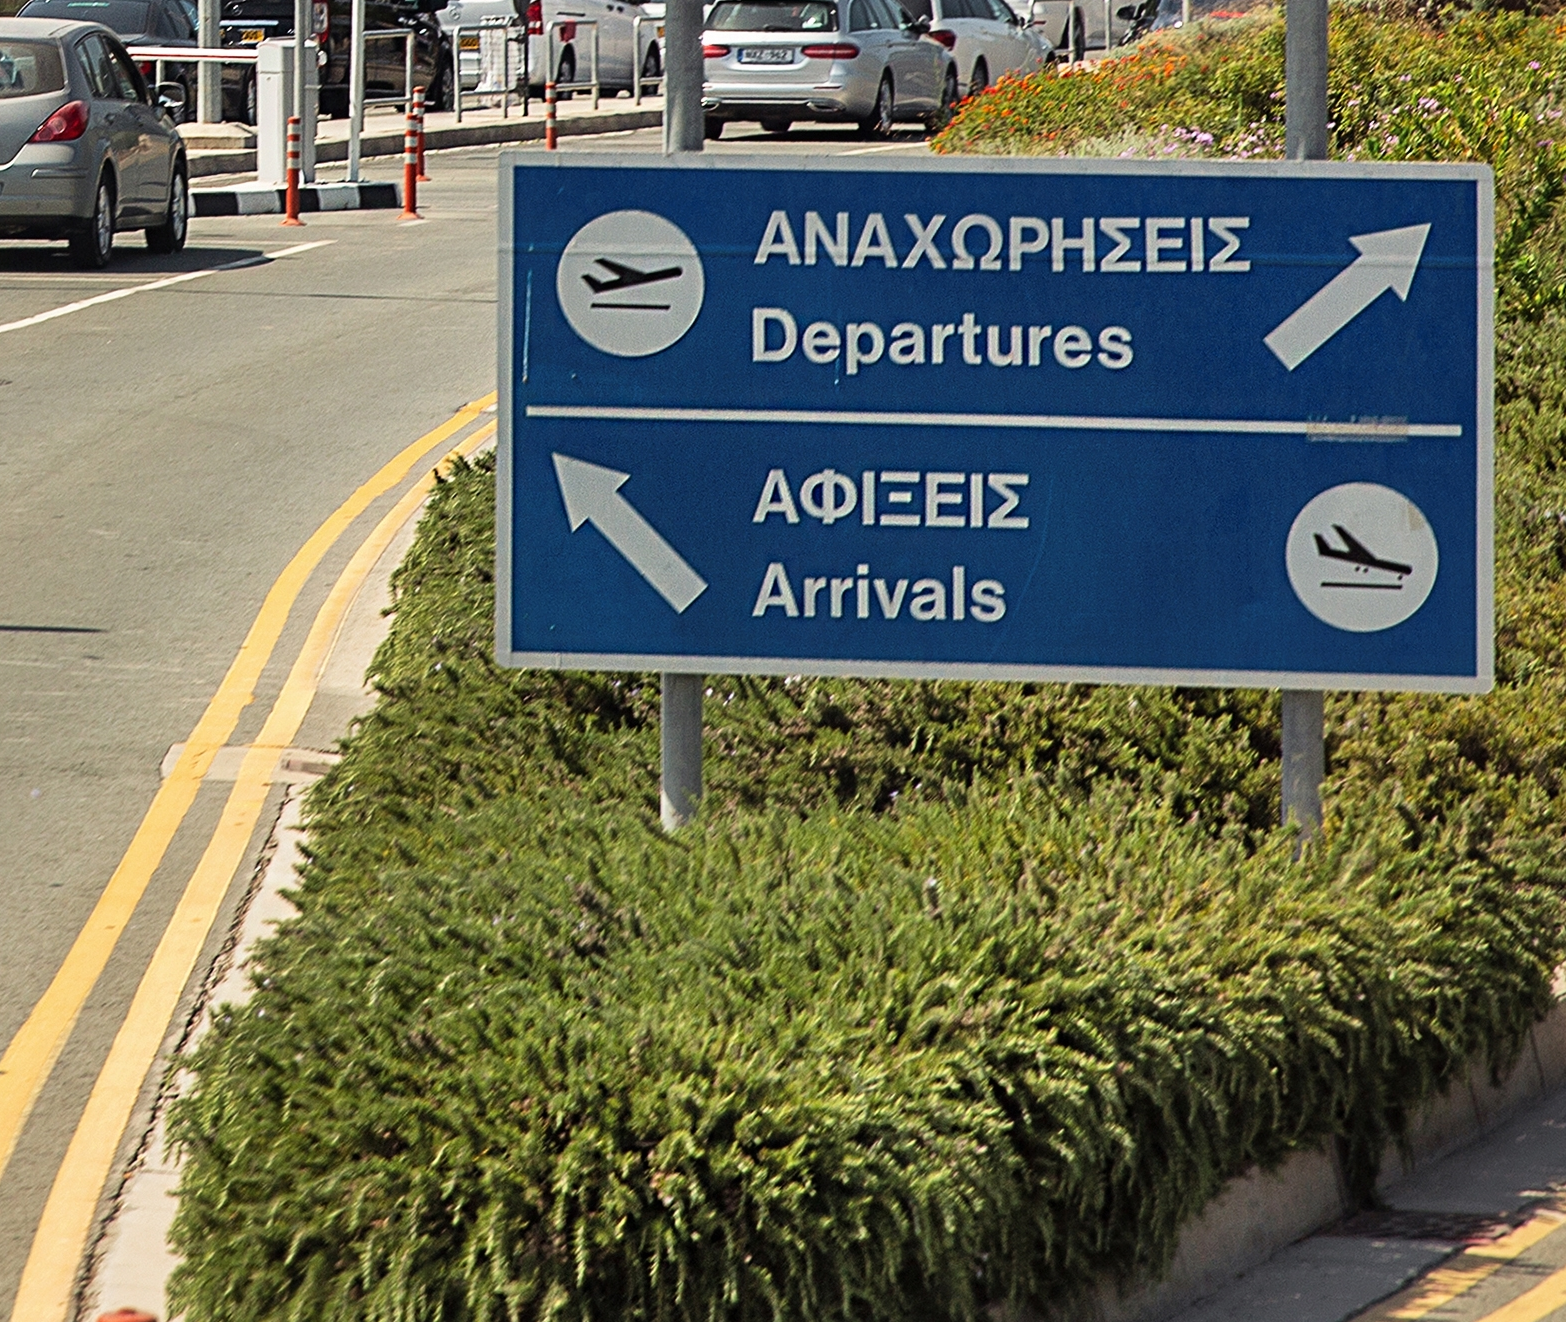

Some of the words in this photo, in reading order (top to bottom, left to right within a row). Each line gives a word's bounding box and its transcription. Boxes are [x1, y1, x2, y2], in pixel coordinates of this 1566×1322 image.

[753, 211, 1251, 274] ΑΝΑΧΩΡΗΣΕΙΣ
[750, 308, 1134, 374] Departures
[752, 470, 1030, 530] ΑΦΙΞΕΙΣ
[751, 564, 1007, 622] Arrivals
